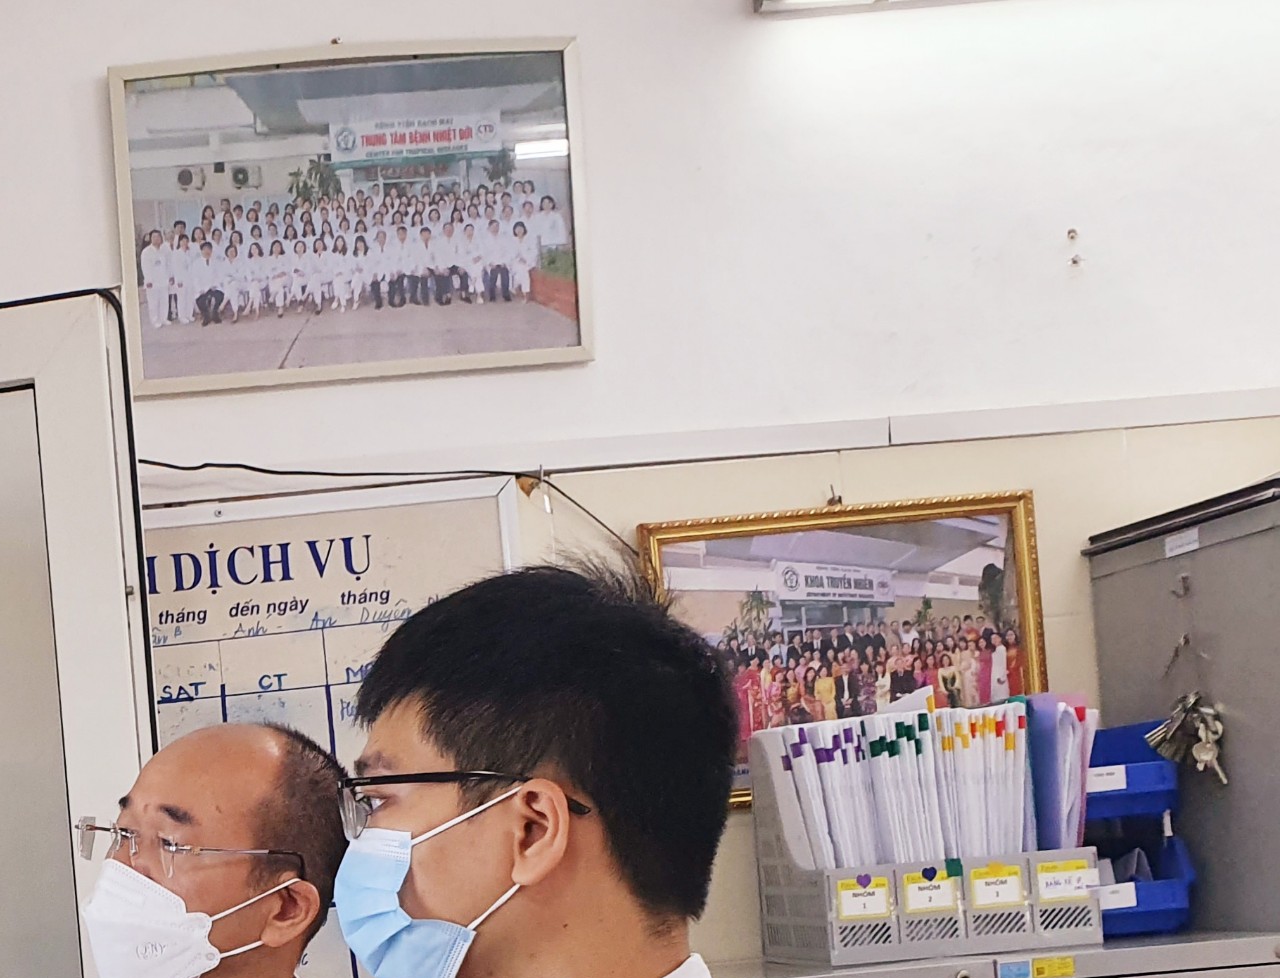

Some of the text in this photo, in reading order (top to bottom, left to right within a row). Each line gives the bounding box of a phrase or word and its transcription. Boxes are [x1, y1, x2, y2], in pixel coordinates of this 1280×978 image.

[170, 542, 294, 595] DỊCH
[305, 534, 372, 582] VỤ
[158, 606, 207, 625] tháng
[266, 596, 310, 616] ngày
[340, 588, 391, 606] tháng
[258, 674, 288, 691] CT
